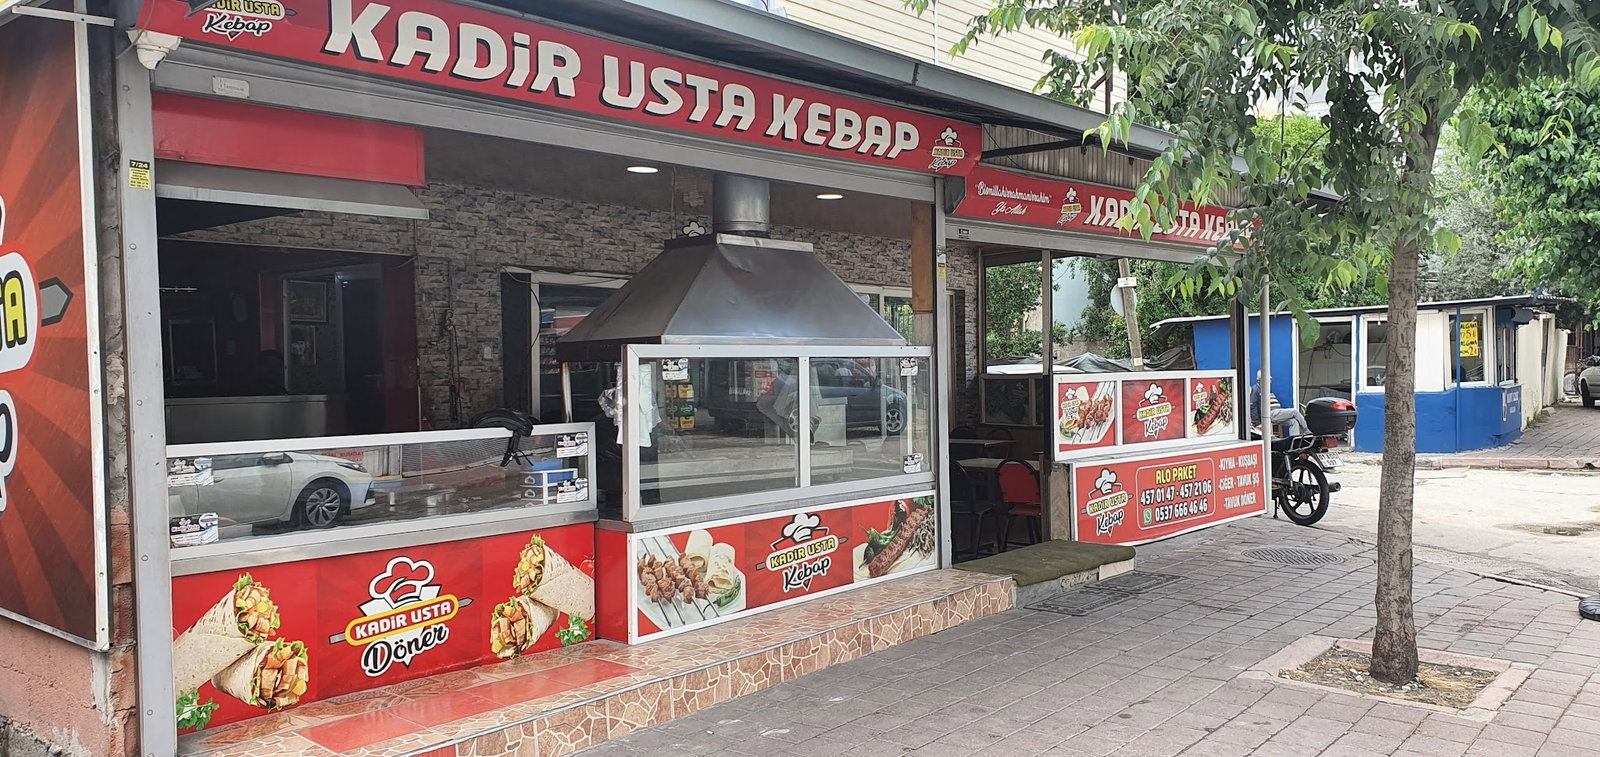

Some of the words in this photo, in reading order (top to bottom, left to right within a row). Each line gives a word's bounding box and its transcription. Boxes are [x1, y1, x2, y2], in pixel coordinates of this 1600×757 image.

[244, 0, 280, 16] USTA
[205, 14, 270, 35] Kebap
[320, 0, 581, 98] KADİR
[601, 55, 756, 132] USTA
[764, 93, 920, 160] KEBAP
[130, 161, 148, 169] 7/24
[1145, 417, 1168, 437] Kebap
[1156, 469, 1171, 485] ALO
[1172, 465, 1197, 482] PAKET
[1237, 473, 1252, 488] TAVUK
[1109, 492, 1126, 506] USTA
[1140, 489, 1155, 506] 457
[1156, 487, 1165, 503] 01
[1166, 485, 1175, 501] 47
[1180, 483, 1193, 499] 457
[1194, 481, 1202, 496] 21
[1202, 479, 1212, 494] 06
[1155, 504, 1173, 522] 0537
[1174, 502, 1188, 518] 666
[1188, 500, 1198, 515] 46
[1198, 498, 1208, 513] 46
[1097, 510, 1124, 535] Kebap
[770, 546, 806, 569] KADİR
[807, 537, 836, 556] USTA
[784, 557, 830, 590] Kebap
[355, 613, 408, 640] KADİR
[411, 601, 452, 623] USTA
[363, 625, 448, 674] Döner
